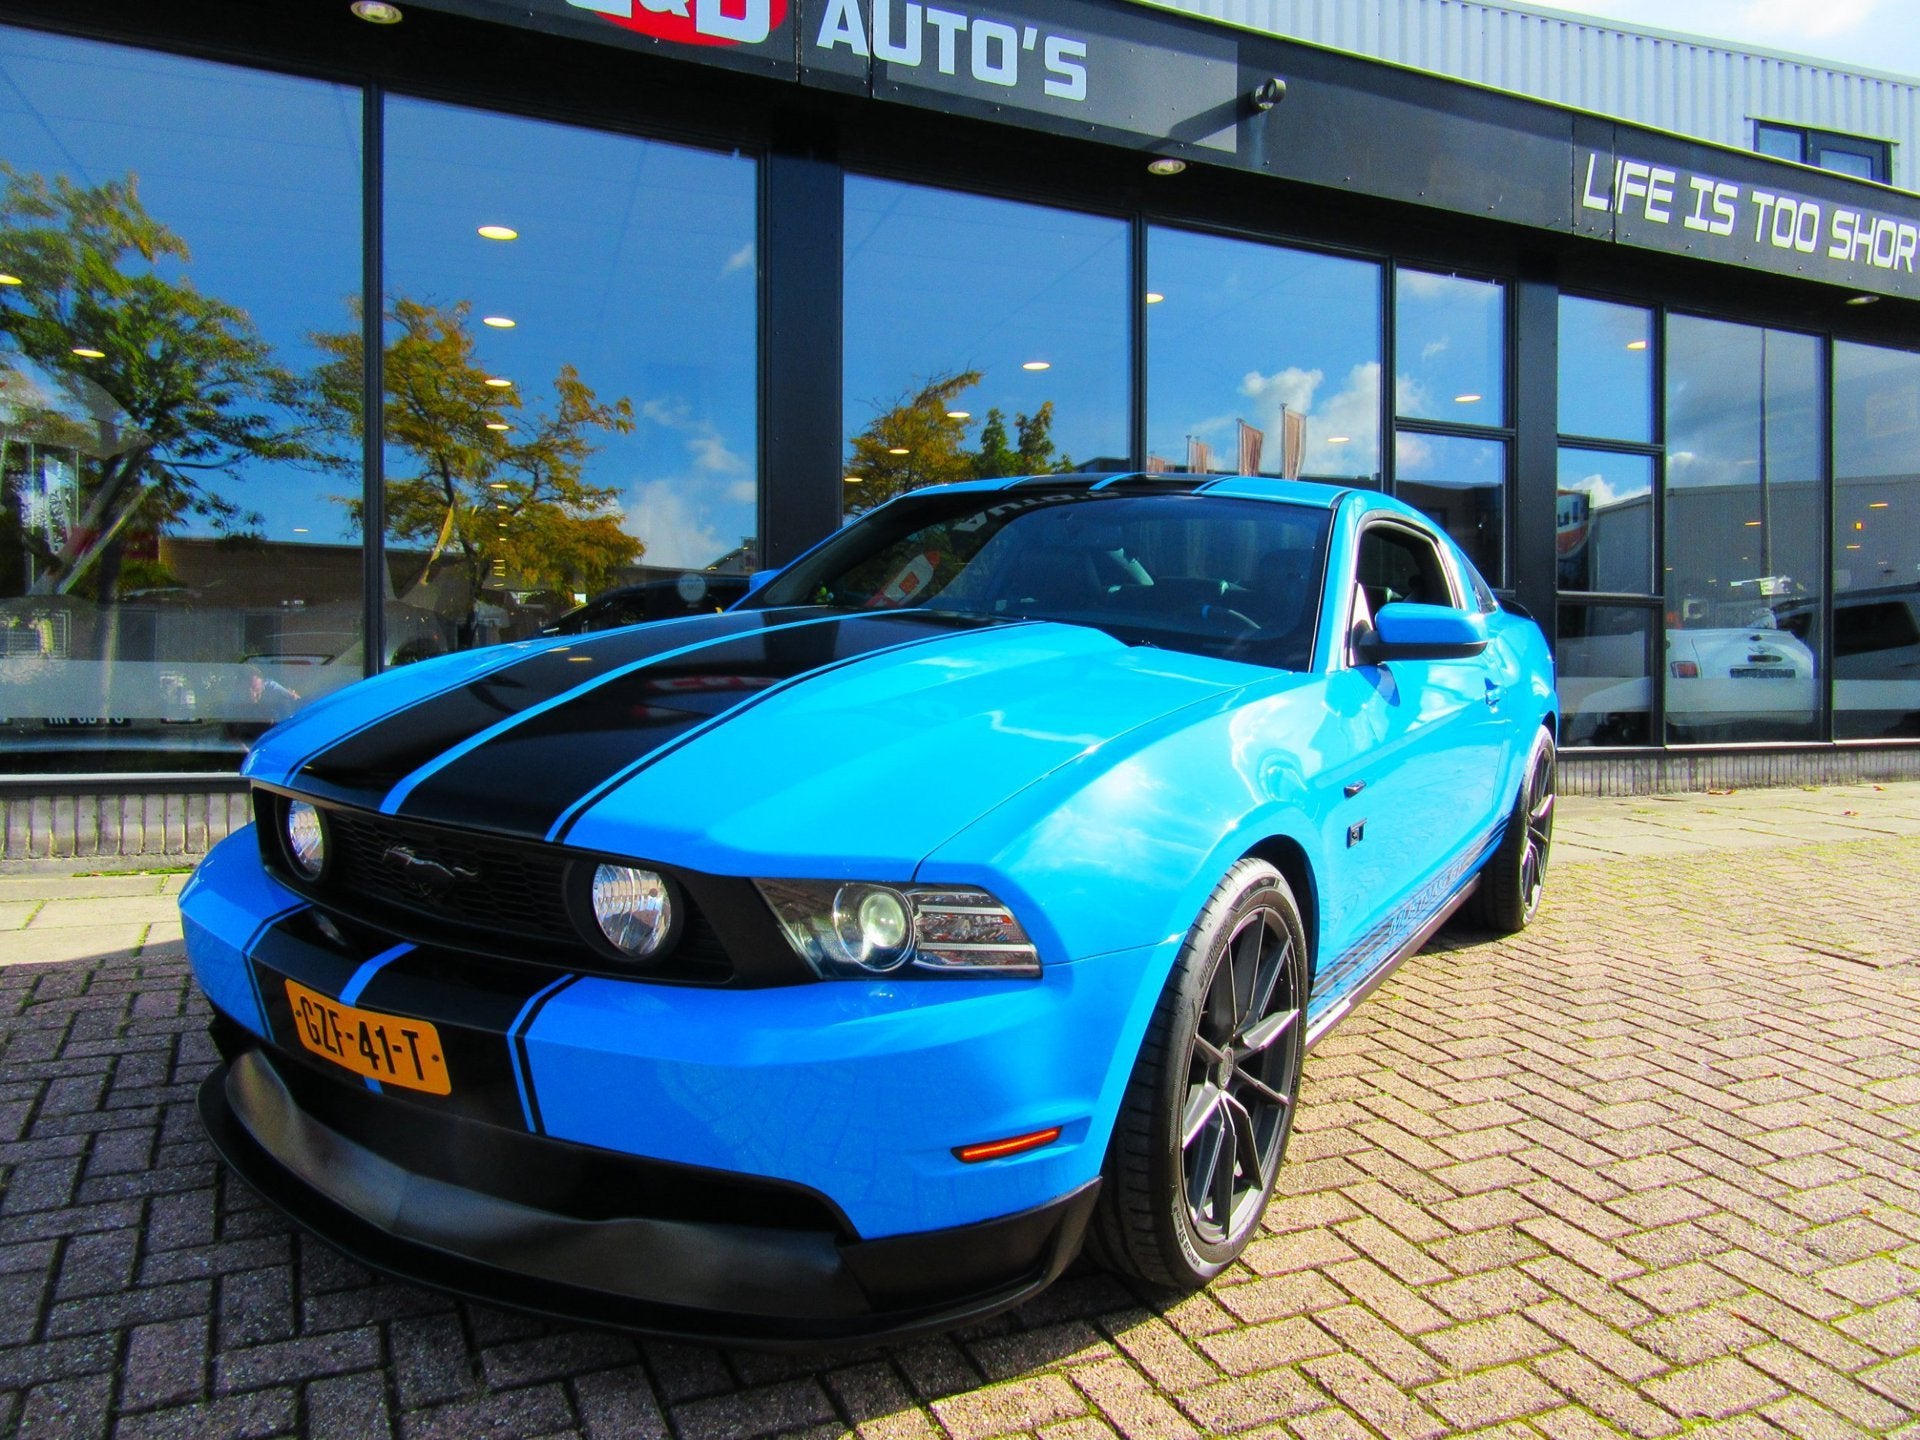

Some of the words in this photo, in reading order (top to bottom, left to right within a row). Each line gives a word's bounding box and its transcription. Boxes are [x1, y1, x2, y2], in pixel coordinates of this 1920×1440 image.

[816, 0, 1087, 101] AUTO'S
[1582, 153, 1676, 224] LIFE
[1683, 176, 1739, 236] IS
[1751, 190, 1820, 254] TOO
[1828, 209, 1920, 273] SHOR
[299, 995, 425, 1081] GZF-41-T
